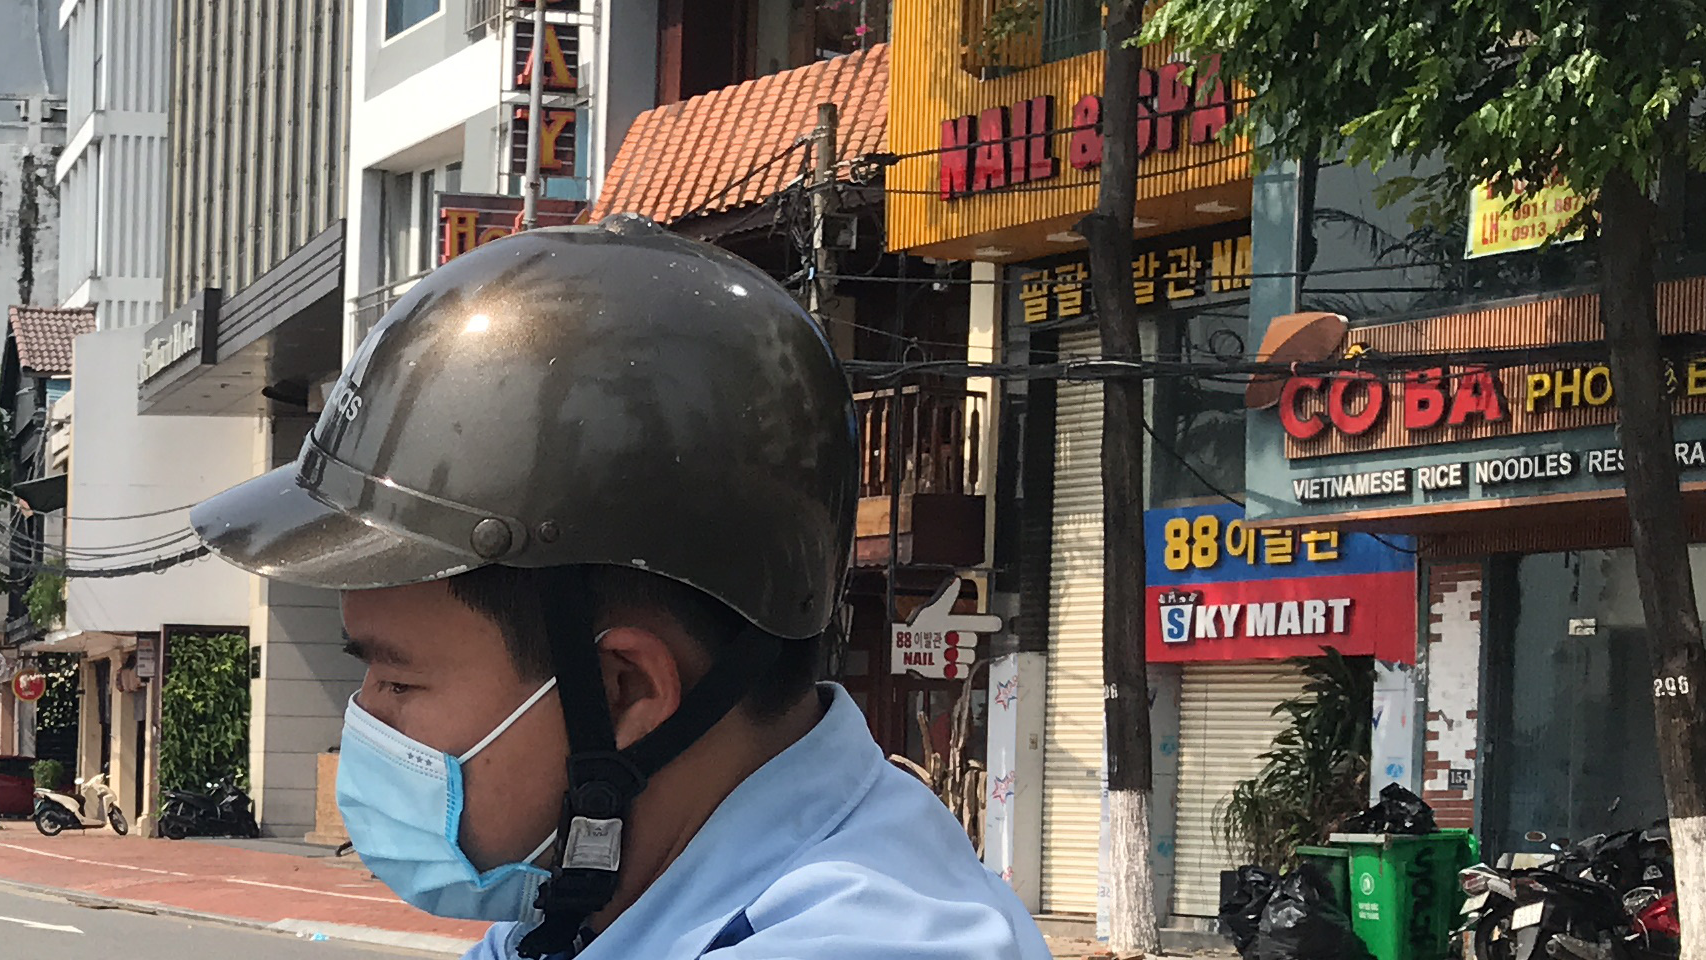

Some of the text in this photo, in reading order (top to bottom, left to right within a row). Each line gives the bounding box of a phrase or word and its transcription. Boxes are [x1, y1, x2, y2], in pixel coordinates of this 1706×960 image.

[939, 95, 1059, 201] NAIL
[1292, 469, 1406, 500] VIETNAMESE
[1417, 463, 1462, 490] RICE
[1475, 452, 1573, 484] NOODLES
[1164, 515, 1219, 570] 88
[1162, 598, 1351, 643] SKY MART
[903, 652, 935, 666] NAIL
[1450, 770, 1467, 784] 154
